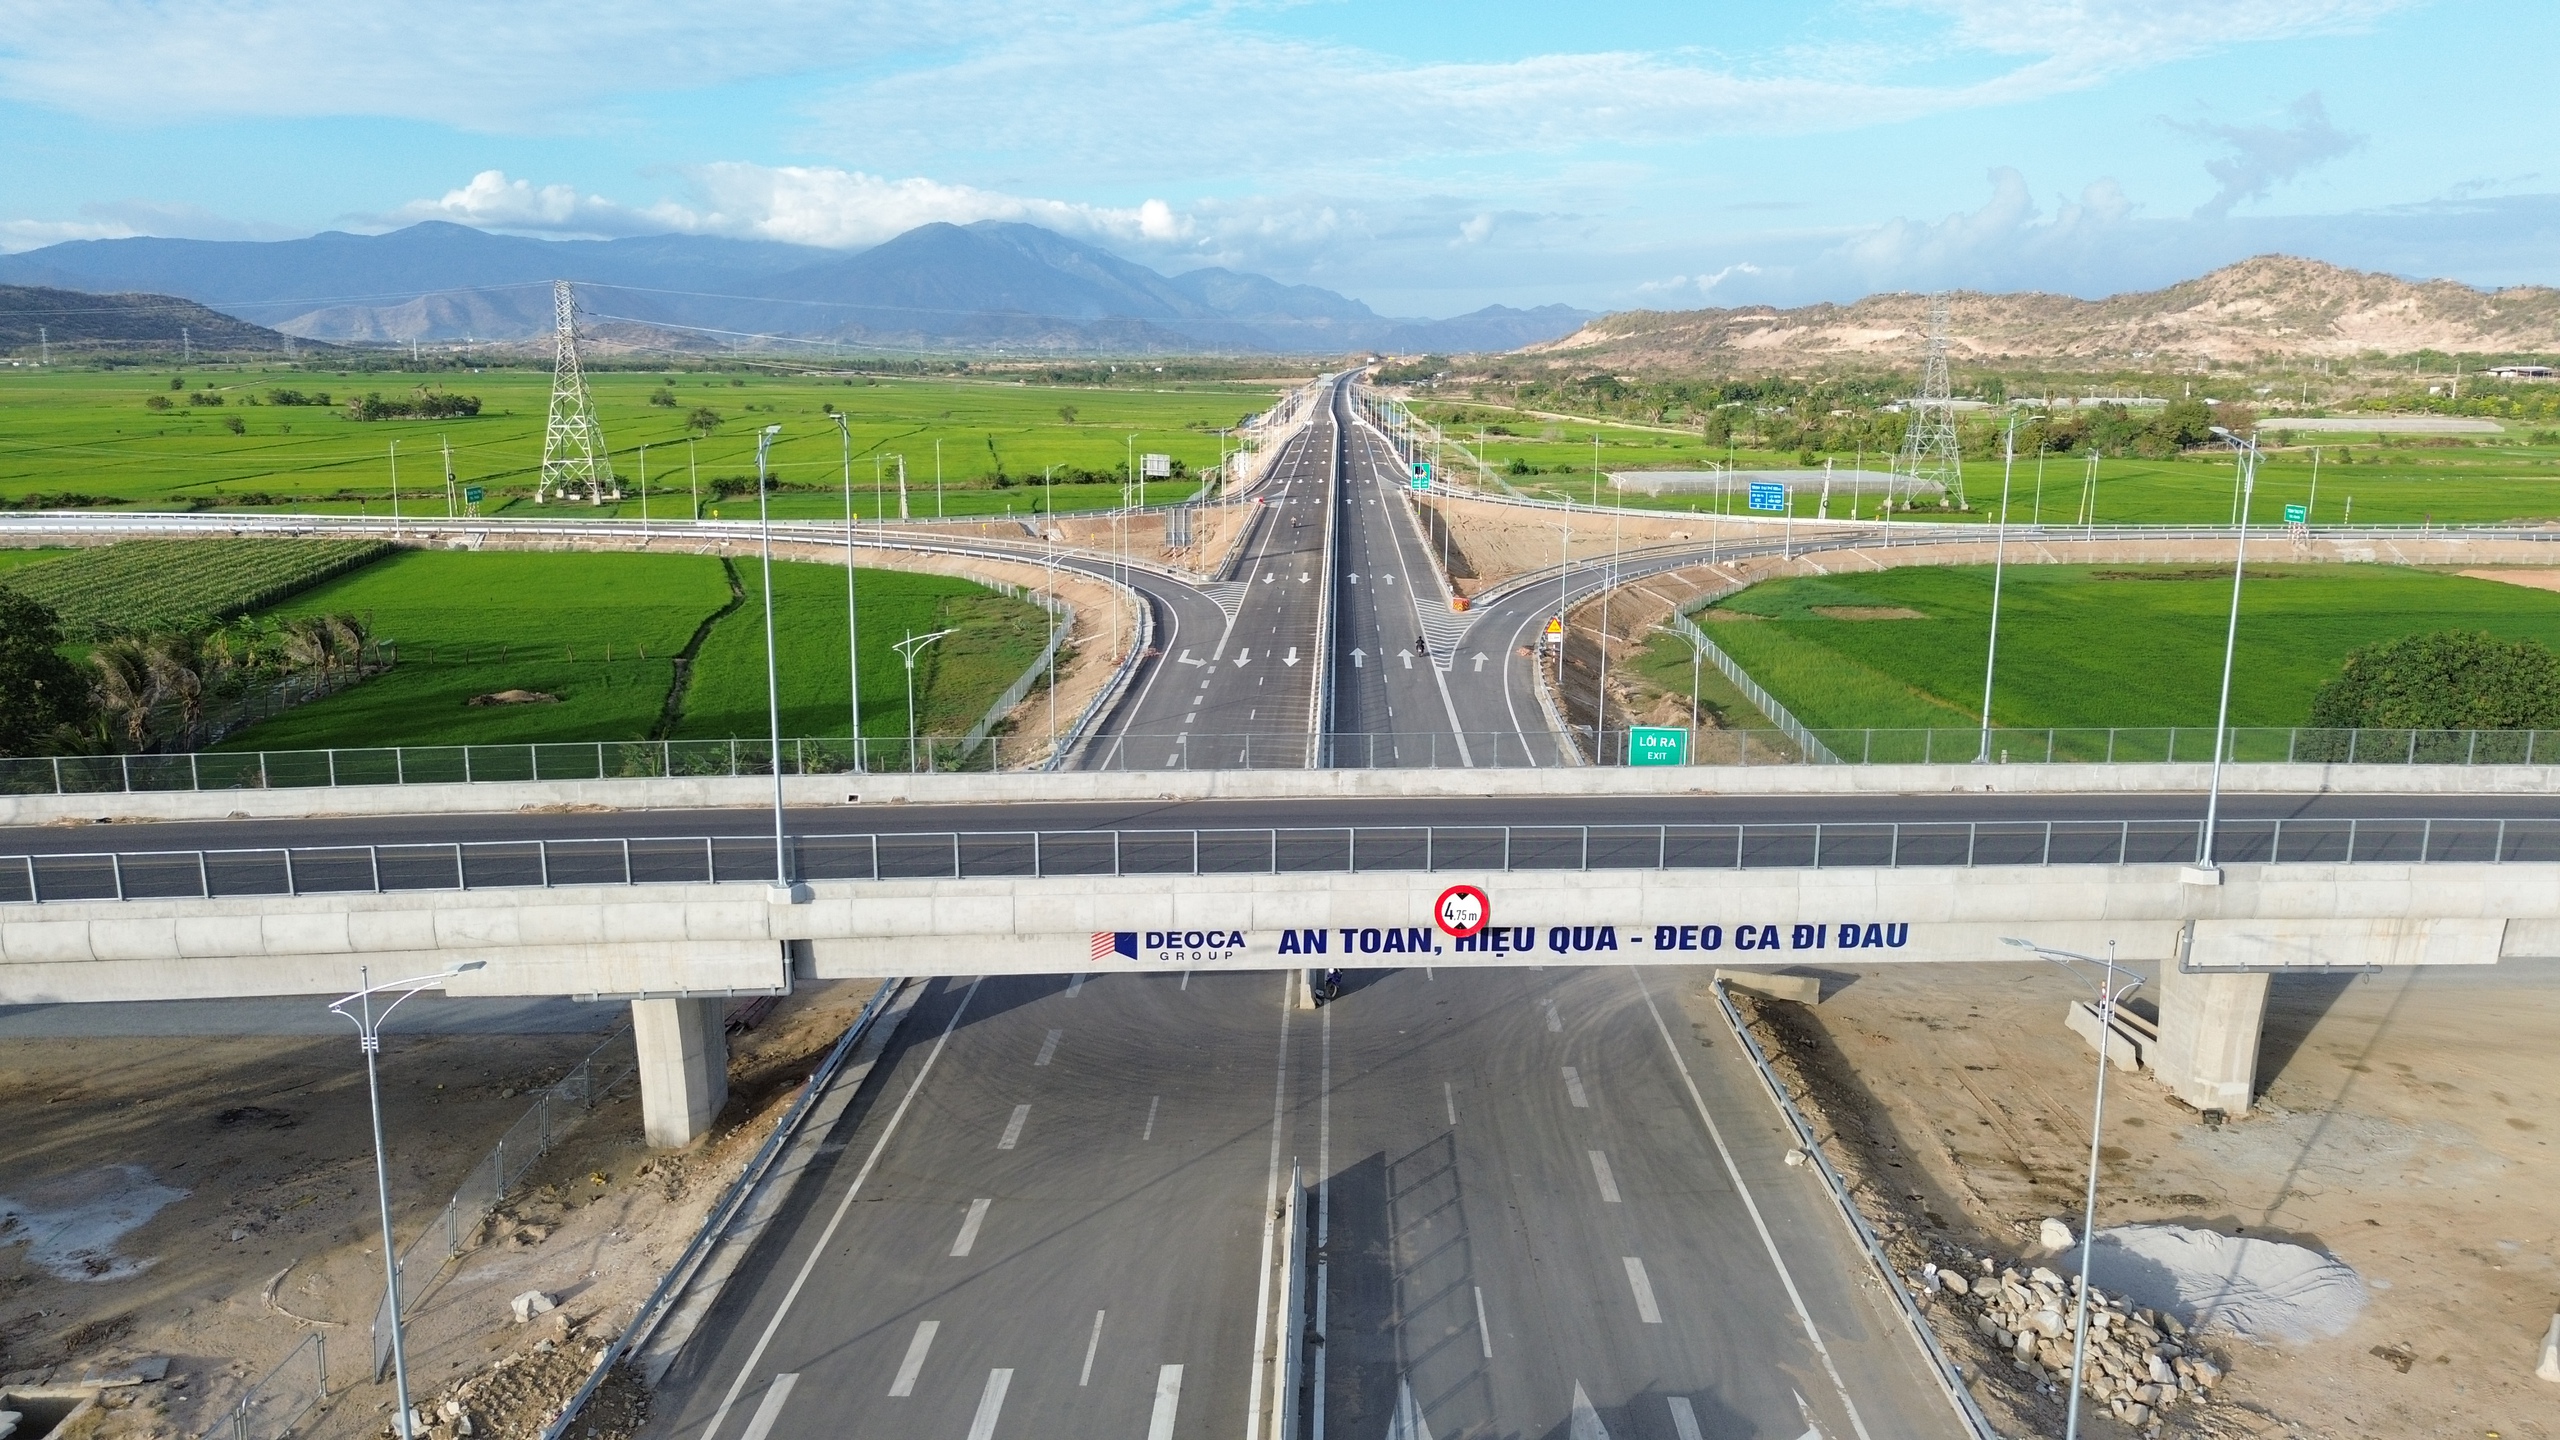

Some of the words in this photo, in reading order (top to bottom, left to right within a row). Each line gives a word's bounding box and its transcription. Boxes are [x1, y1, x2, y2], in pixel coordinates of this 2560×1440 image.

[1640, 733, 1657, 747] LỐI
[1660, 737, 1676, 748] RA
[1647, 752, 1667, 760] EXIT
[1146, 931, 1246, 948] DEOCA
[1278, 929, 1328, 954] AN
[1340, 928, 1442, 956] TOAN,
[1549, 926, 1618, 954] QUA
[1735, 925, 1780, 950] CA
[1792, 924, 1827, 949] ĐI
[1160, 952, 1233, 960] GROUP
